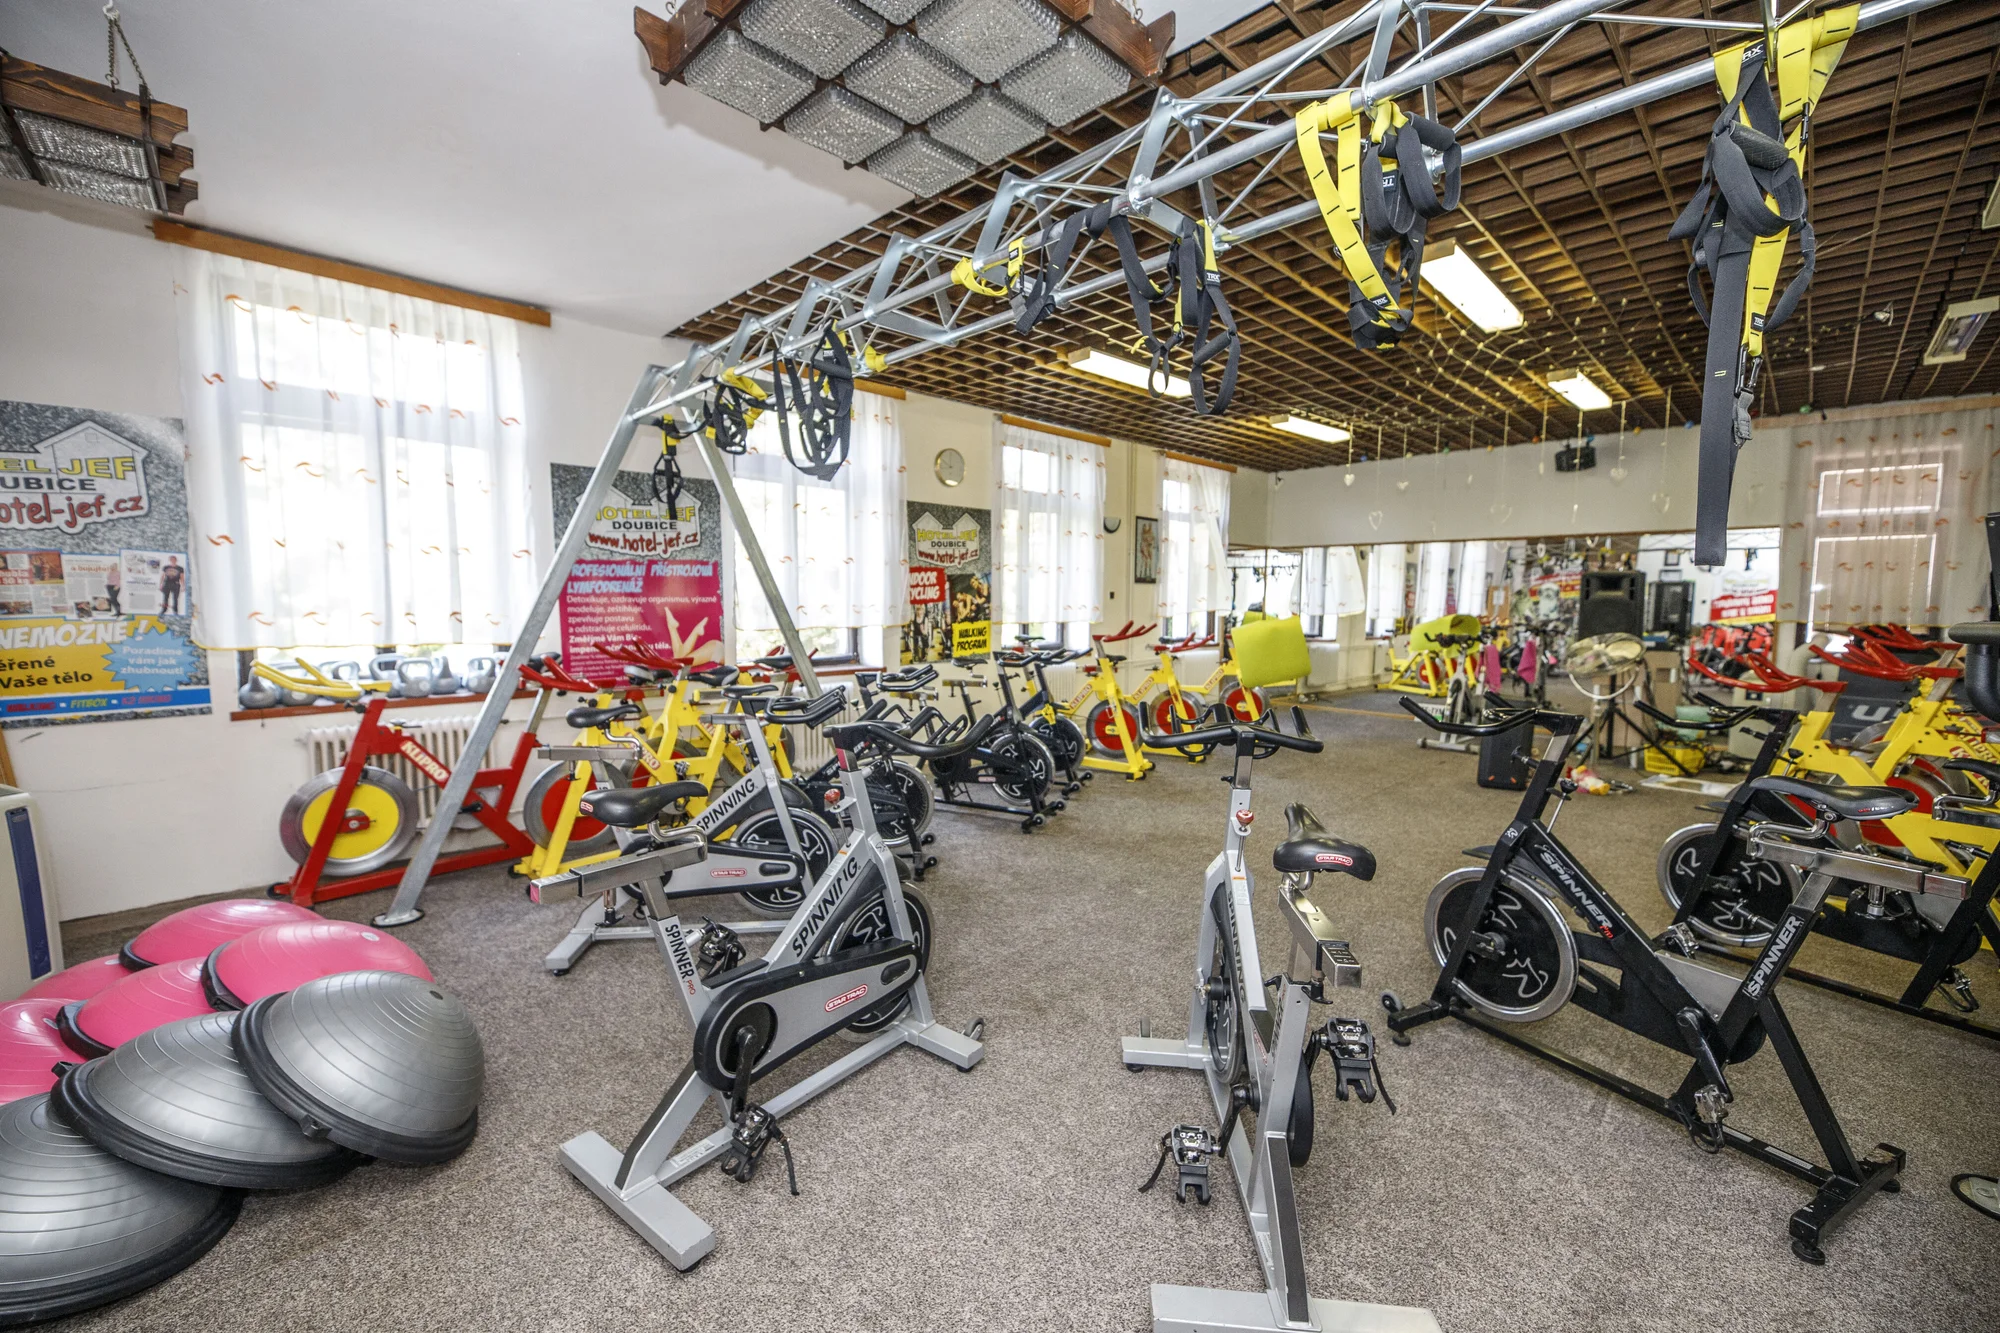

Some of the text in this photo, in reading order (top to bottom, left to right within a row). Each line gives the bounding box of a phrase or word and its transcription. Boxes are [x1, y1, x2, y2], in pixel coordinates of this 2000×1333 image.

[58, 456, 136, 480] JEF
[612, 521, 677, 530] DOUBICE
[917, 529, 978, 542] HOTEL JEF
[588, 531, 699, 554] www.hotel-jef.cz
[931, 540, 966, 548] DOUBICE
[918, 549, 979, 566] www.hotel-jef.cz
[571, 561, 648, 577] ROFESIONÁLNÍ
[958, 626, 987, 638] WALKING
[956, 639, 987, 651] PROGRAM
[0, 671, 93, 689] Vaše tělo
[401, 740, 450, 781] KLIPRO
[697, 778, 756, 831] SPINNING
[1540, 851, 1613, 929] SPINNER
[665, 924, 696, 996] SPINNER PRO
[1748, 915, 1801, 997] SPINNER
[827, 987, 866, 1009] STAR TRAC
